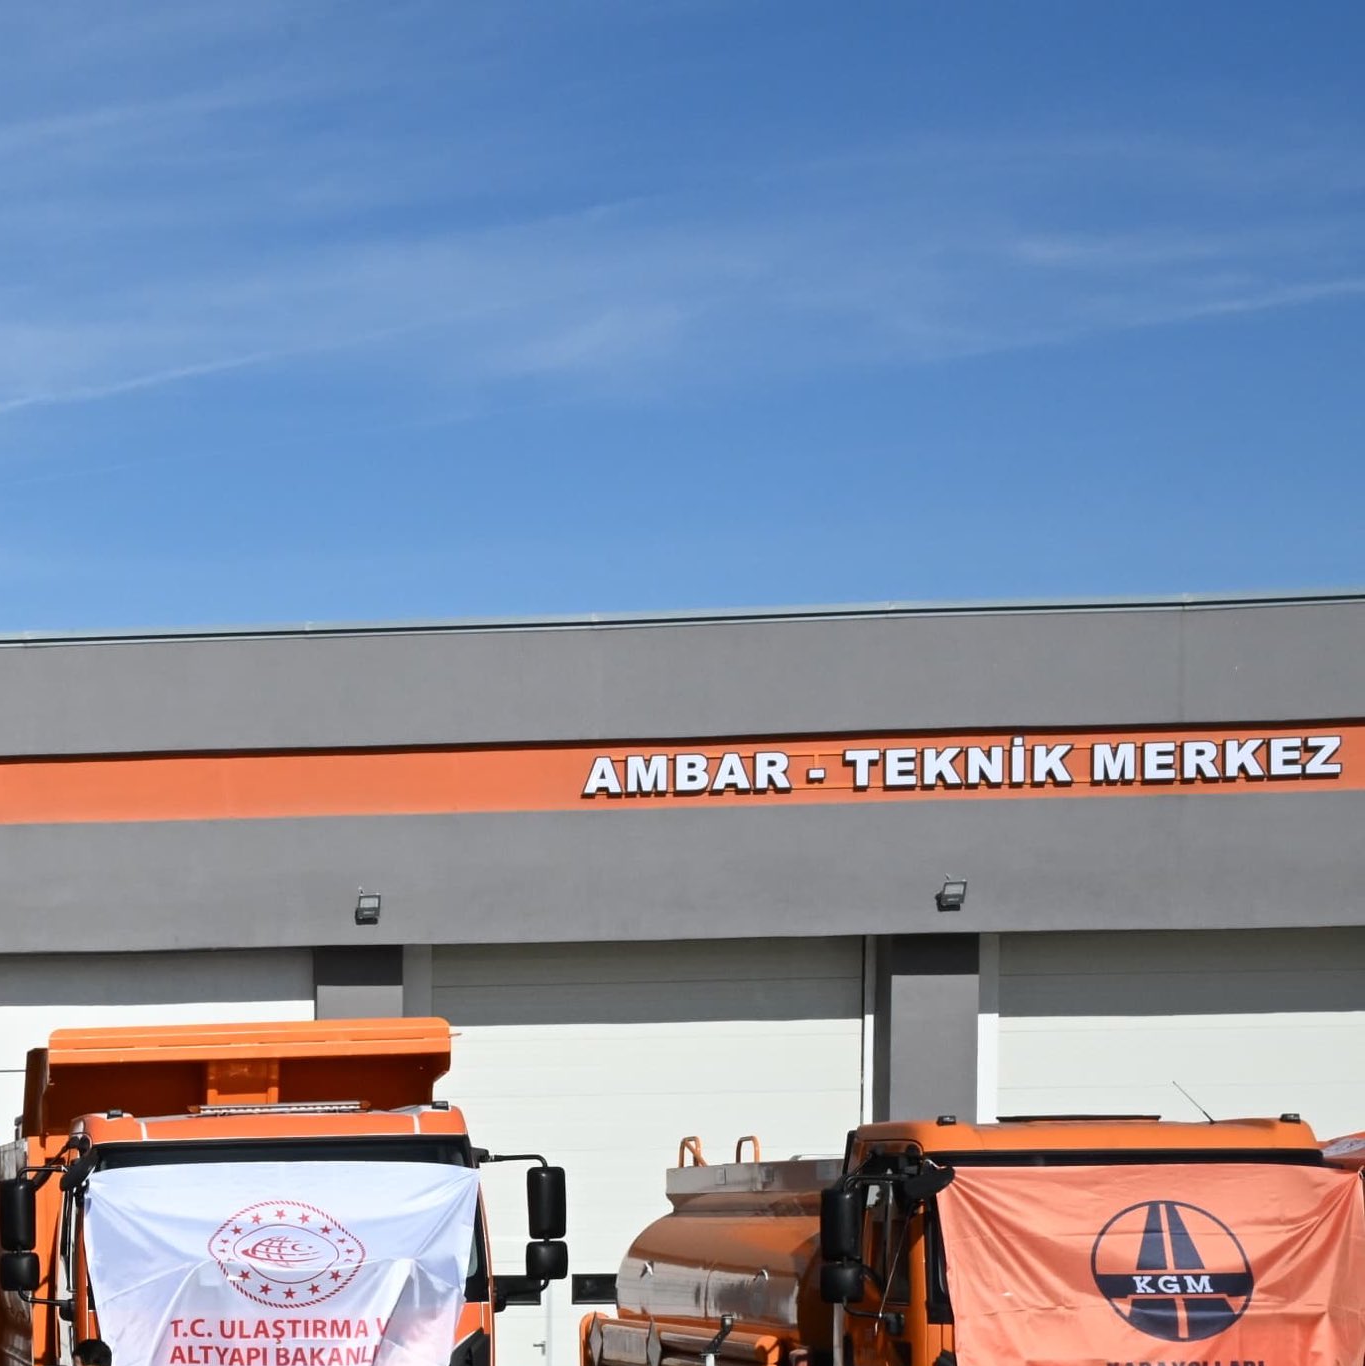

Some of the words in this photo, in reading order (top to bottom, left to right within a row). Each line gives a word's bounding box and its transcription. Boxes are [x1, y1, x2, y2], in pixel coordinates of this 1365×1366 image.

[583, 751, 791, 794] AMBAR
[844, 736, 1072, 787] TEKNİK
[1093, 735, 1342, 781] MERKEZ
[1132, 1275, 1214, 1294] KGM
[170, 1318, 213, 1338] T.C.
[220, 1318, 368, 1345] ULAŞTIRMA
[169, 1345, 268, 1366] ALTYAPI
[275, 1344, 380, 1366] BAKANLI
